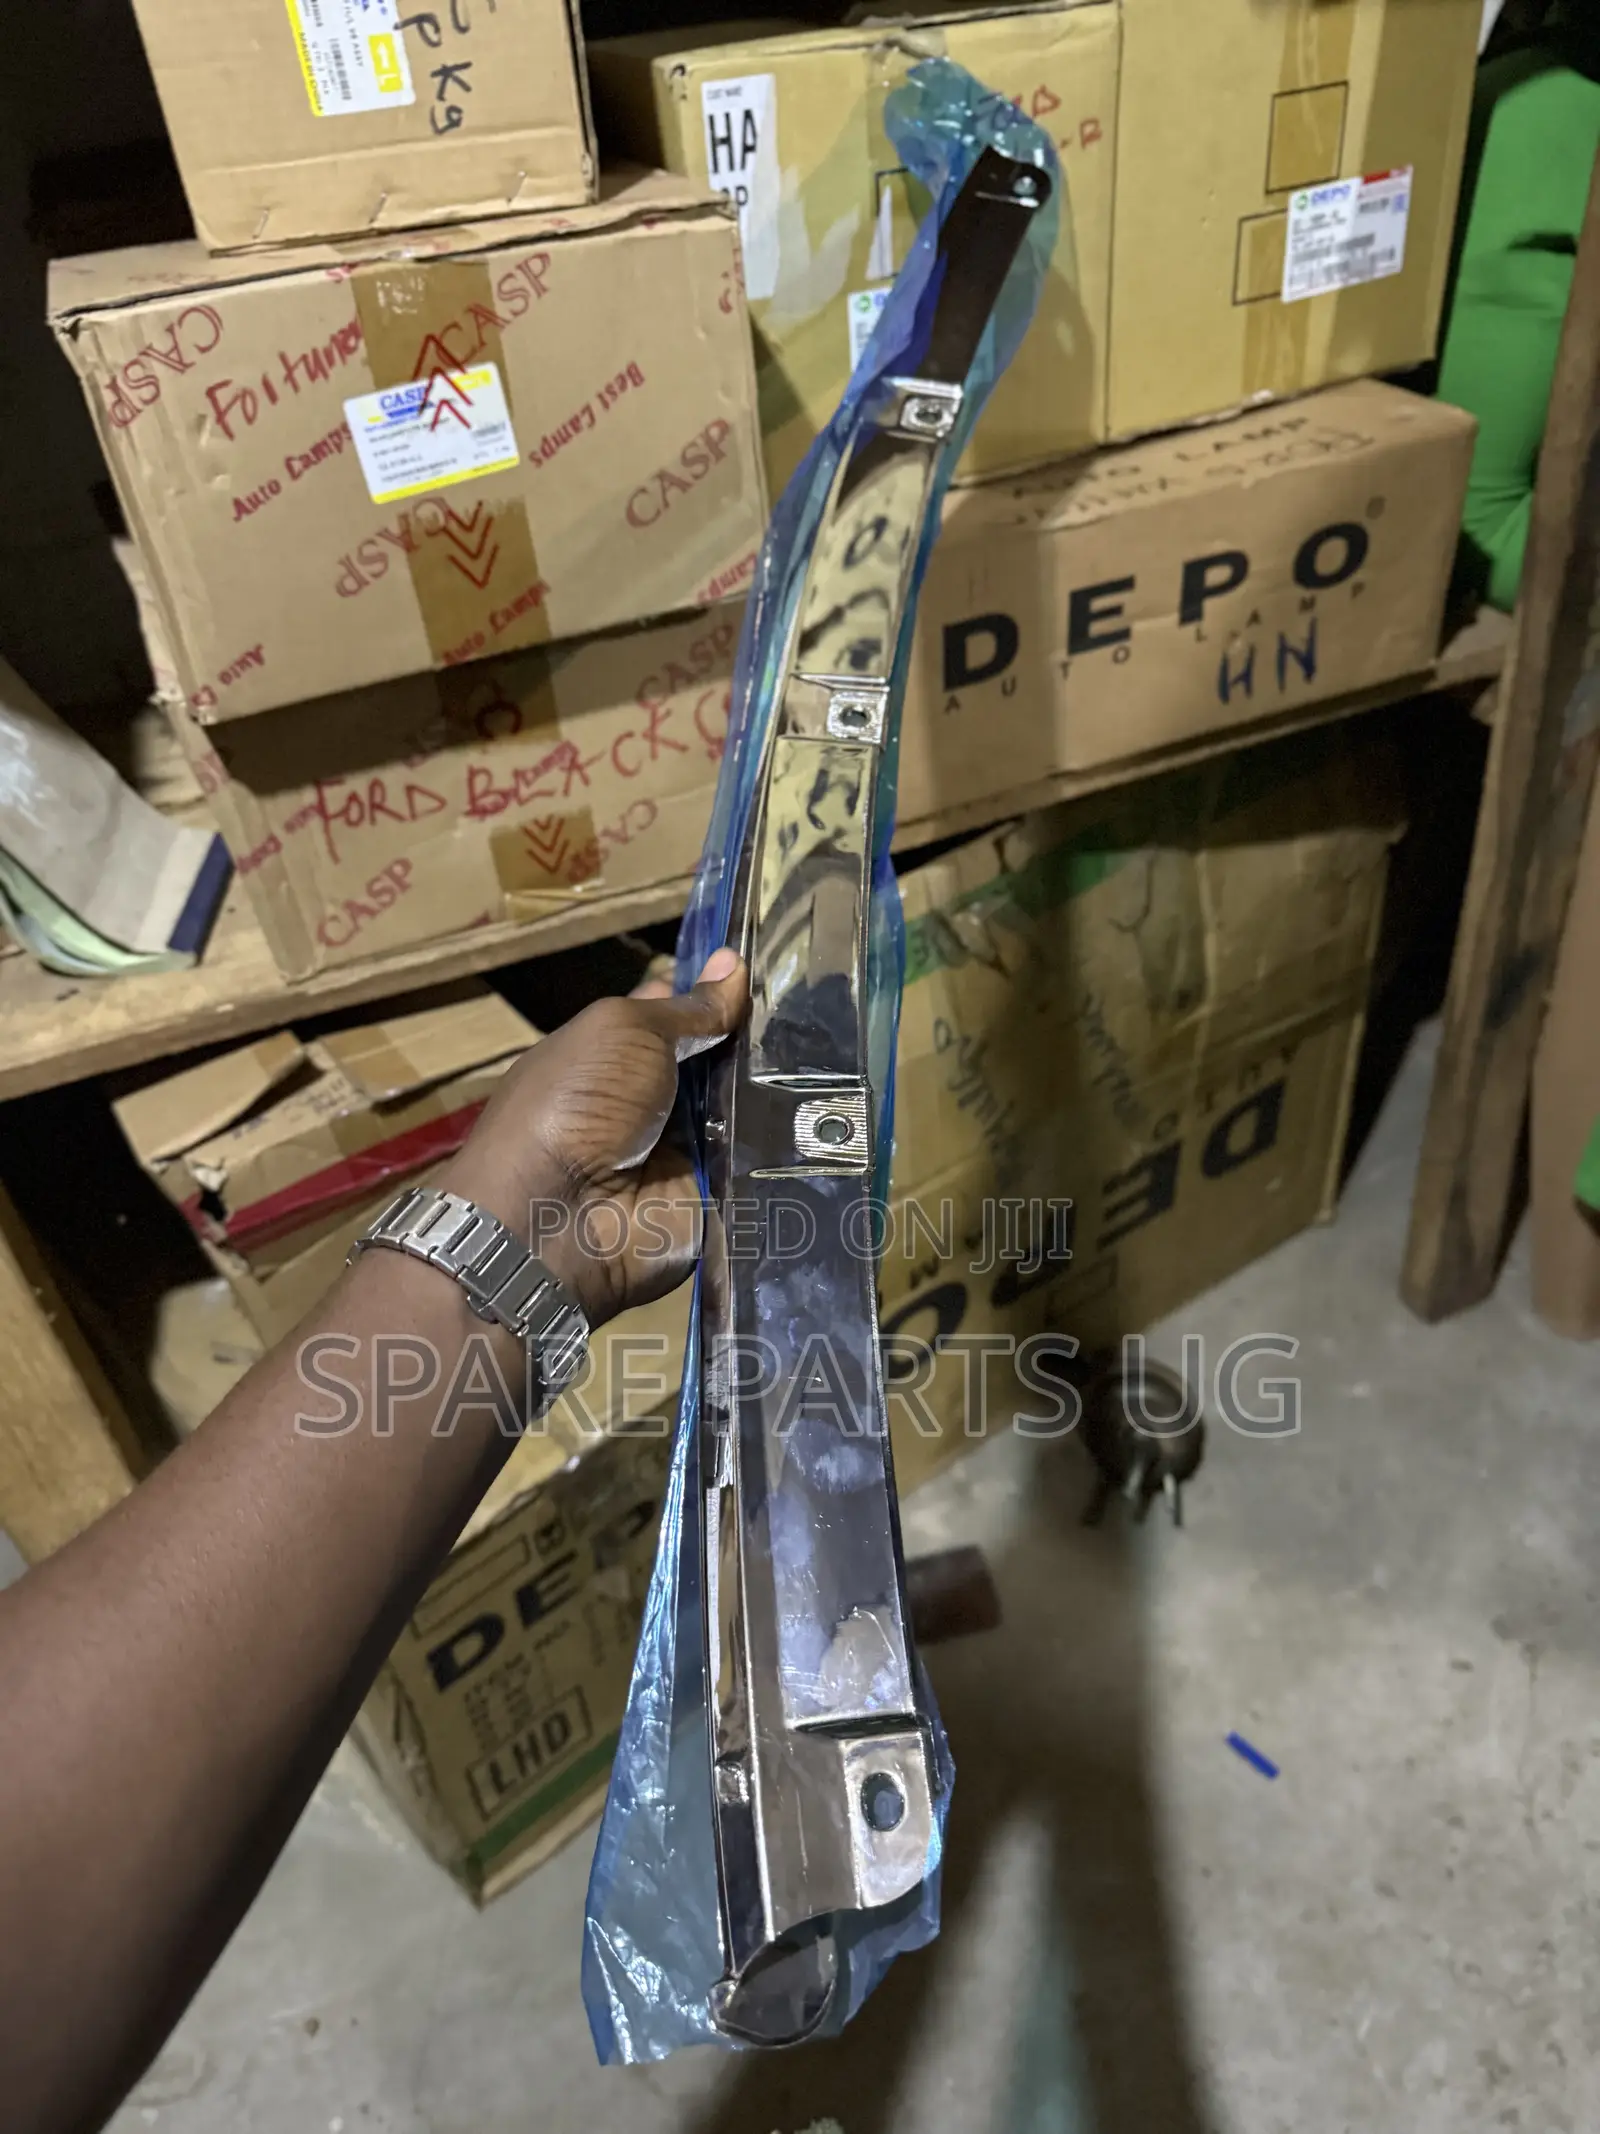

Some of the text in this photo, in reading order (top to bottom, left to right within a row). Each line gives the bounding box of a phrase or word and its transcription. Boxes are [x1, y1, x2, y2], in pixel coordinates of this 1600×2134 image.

[436, 252, 551, 371] CASP
[107, 304, 224, 429] CASP
[596, 360, 646, 412] Best
[232, 479, 283, 523] Auto
[624, 416, 732, 530] CASP
[335, 496, 450, 600] CASP
[942, 521, 1369, 693] DEPO
[216, 643, 266, 687] Auto
[635, 621, 735, 711] CASP
[315, 777, 448, 866] FORD
[316, 857, 413, 948] CASP
[488, 1710, 573, 1796] LHD
